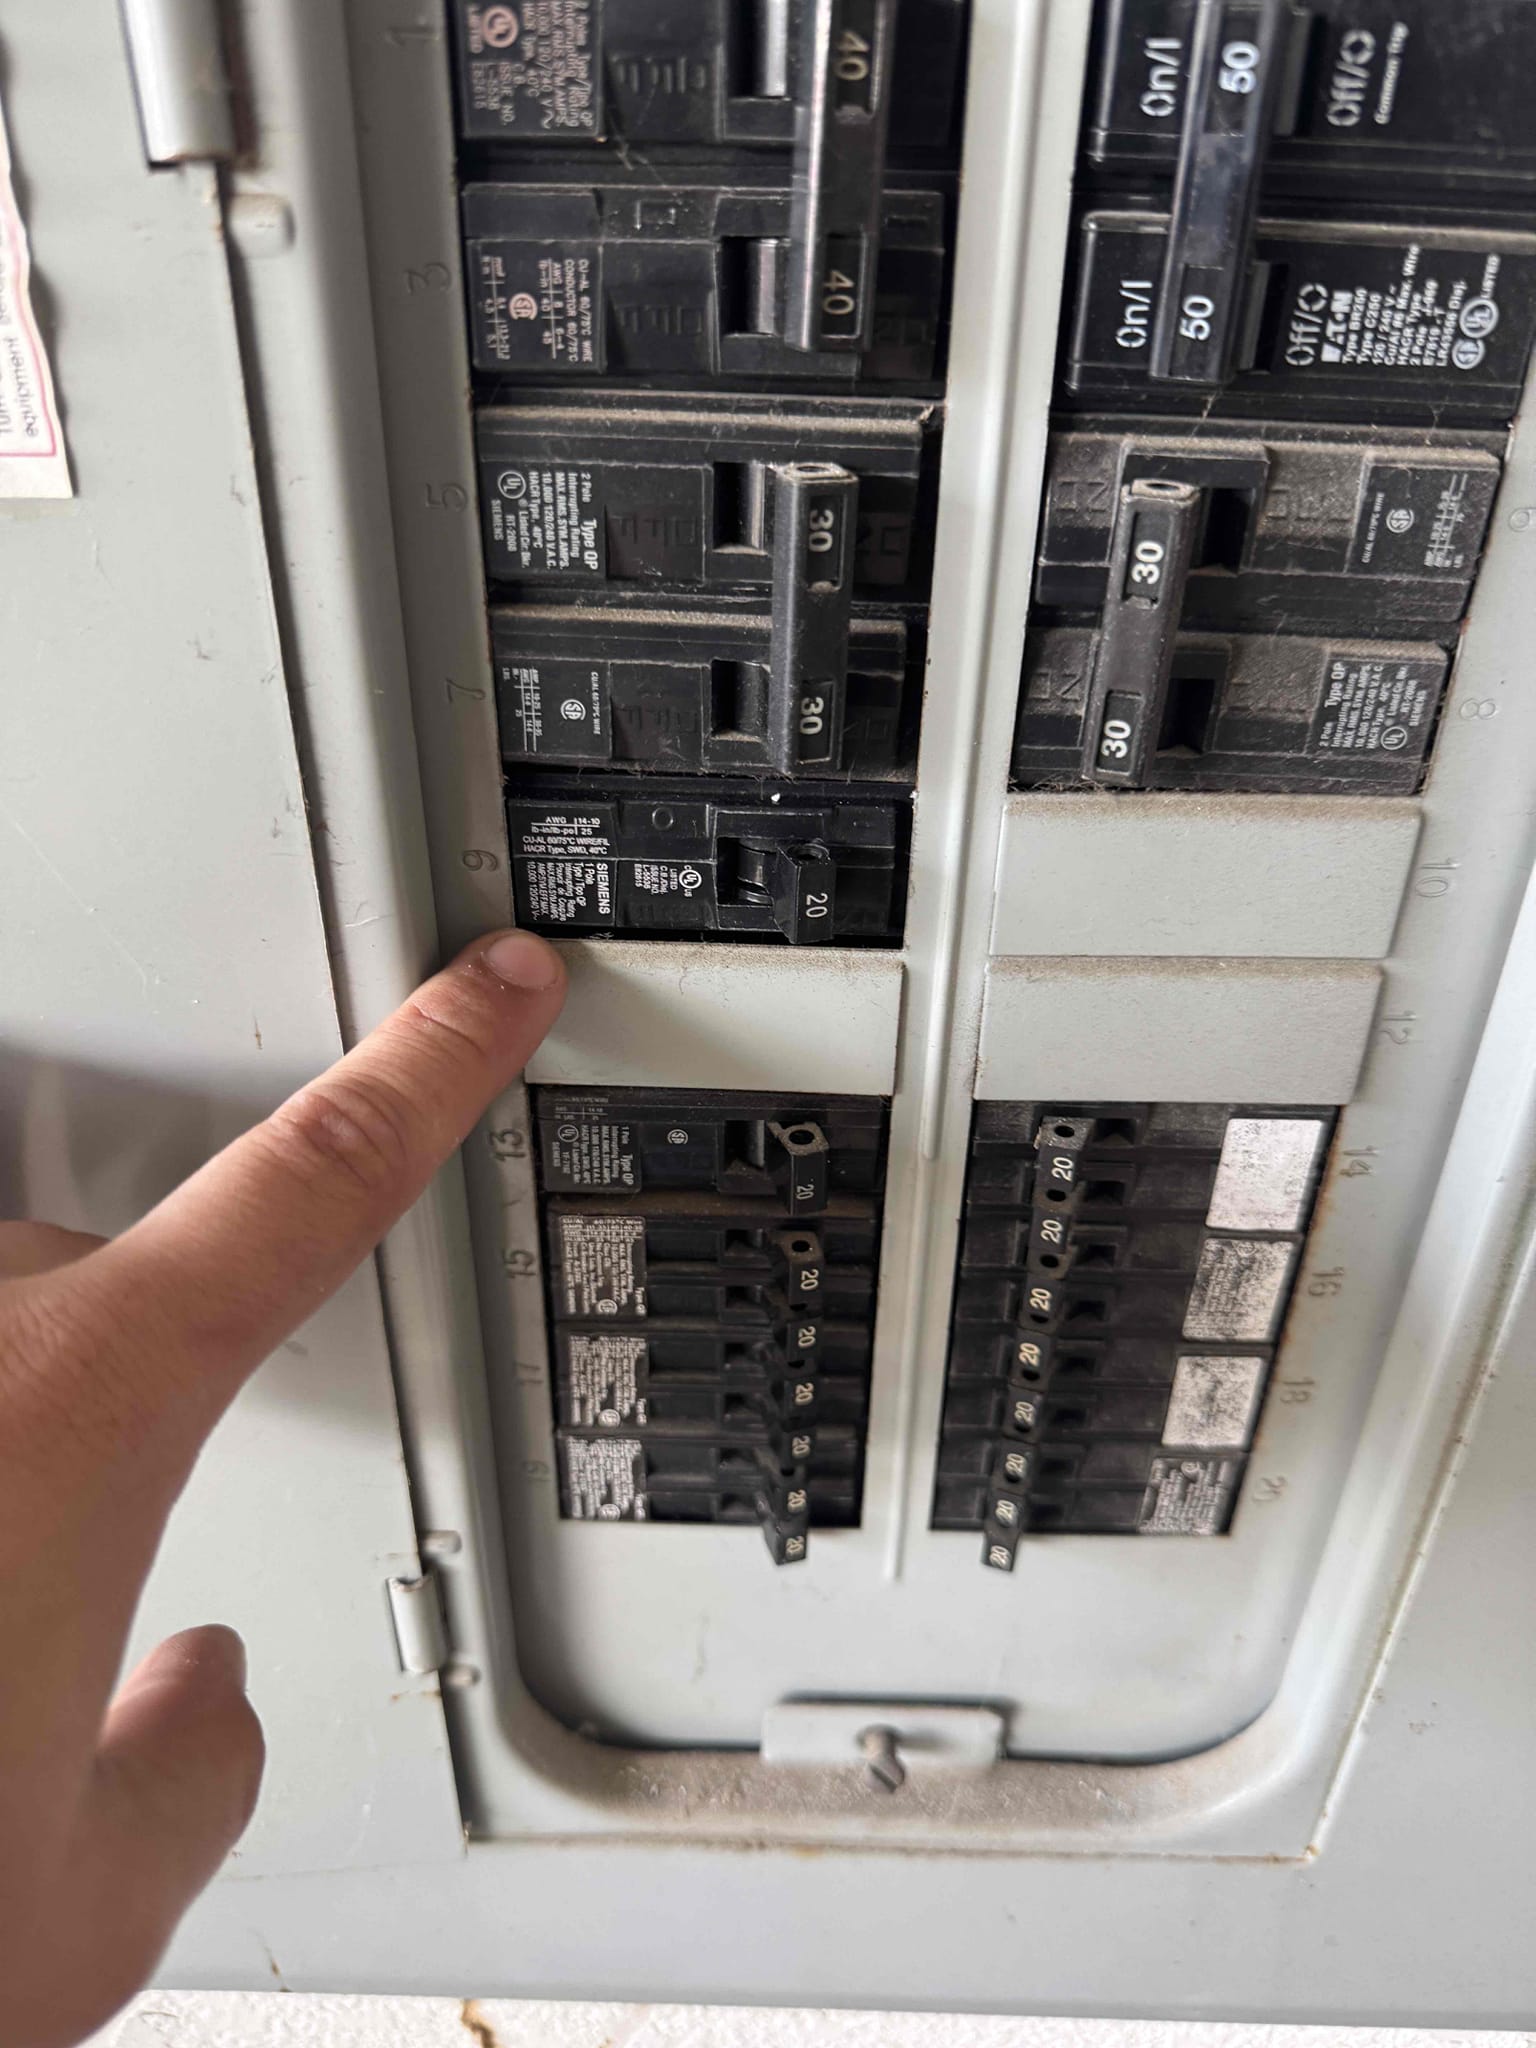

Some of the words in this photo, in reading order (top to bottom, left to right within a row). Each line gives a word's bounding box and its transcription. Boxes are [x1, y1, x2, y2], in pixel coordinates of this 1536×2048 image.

[833, 30, 871, 81] 40
[1217, 41, 1260, 94] 50
[1373, 54, 1402, 125] Common
[1402, 244, 1421, 276] Wire
[405, 262, 452, 295] 3
[565, 259, 576, 316] CONDUCTOR
[1480, 255, 1501, 298] LISTED
[823, 269, 858, 316] 40
[1180, 294, 1214, 341] 50
[1379, 310, 1392, 332] 240
[1398, 326, 1413, 365] HACR
[1406, 293, 1422, 323] Type
[582, 340, 592, 362] WIRE
[1342, 333, 1358, 363] Type
[1357, 331, 1373, 363] Type
[1412, 326, 1427, 355] Pole
[1373, 342, 1386, 365] 120
[2, 338, 39, 438] equipment
[423, 482, 468, 512] 5
[529, 472, 540, 497] HACR
[582, 482, 592, 503] Pole
[569, 473, 579, 526] Interrupting
[1374, 492, 1385, 512] WIRE
[491, 500, 503, 540] SIEMENS
[519, 511, 529, 535] Listed
[543, 505, 555, 541] 120/240
[807, 508, 833, 553] 30
[570, 528, 580, 558] Rating
[581, 519, 597, 547] Type
[584, 551, 598, 570] QP
[1131, 541, 1164, 584] 30
[1331, 662, 1345, 679] QP
[446, 678, 486, 703] 7
[1324, 682, 1341, 707] Type
[798, 696, 824, 735] 30
[1332, 702, 1350, 747] Interrupting
[1343, 673, 1358, 700] Rating
[1459, 697, 1497, 720] 8
[1101, 719, 1131, 758] 30
[1321, 722, 1332, 739] Pole
[524, 845, 546, 853] HACR
[527, 861, 537, 883] 10,000
[557, 863, 565, 884] Pouvoir
[565, 863, 574, 896] Interrupting
[574, 862, 584, 877] Type
[586, 869, 595, 884] Pole
[650, 865, 658, 883] ISSUE
[1415, 857, 1460, 898] 10
[530, 884, 538, 909] 120/240
[576, 896, 586, 906] QP
[596, 863, 610, 914] SIEMENS
[567, 899, 575, 917] Rating
[805, 892, 829, 919] 20
[620, 1154, 633, 1171] Type
[1052, 1157, 1073, 1181] 20
[1339, 1143, 1379, 1178] 14
[622, 1173, 633, 1185] QP
[796, 1184, 815, 1200] 20
[1040, 1219, 1063, 1242] 20
[502, 1249, 537, 1280] 15
[799, 1269, 819, 1291] 20
[1307, 1265, 1345, 1298] 16
[1030, 1288, 1051, 1310] 20
[797, 1326, 816, 1346] 20
[1019, 1343, 1040, 1366] 20
[795, 1382, 814, 1405] 20
[1279, 1378, 1316, 1408] 18
[1014, 1401, 1033, 1422] 20
[792, 1435, 811, 1454] 20
[1005, 1454, 1024, 1472] 20
[787, 1490, 807, 1508] 20
[995, 1500, 1014, 1519] 20
[787, 1536, 804, 1554] 20
[989, 1546, 1009, 1565] 20
